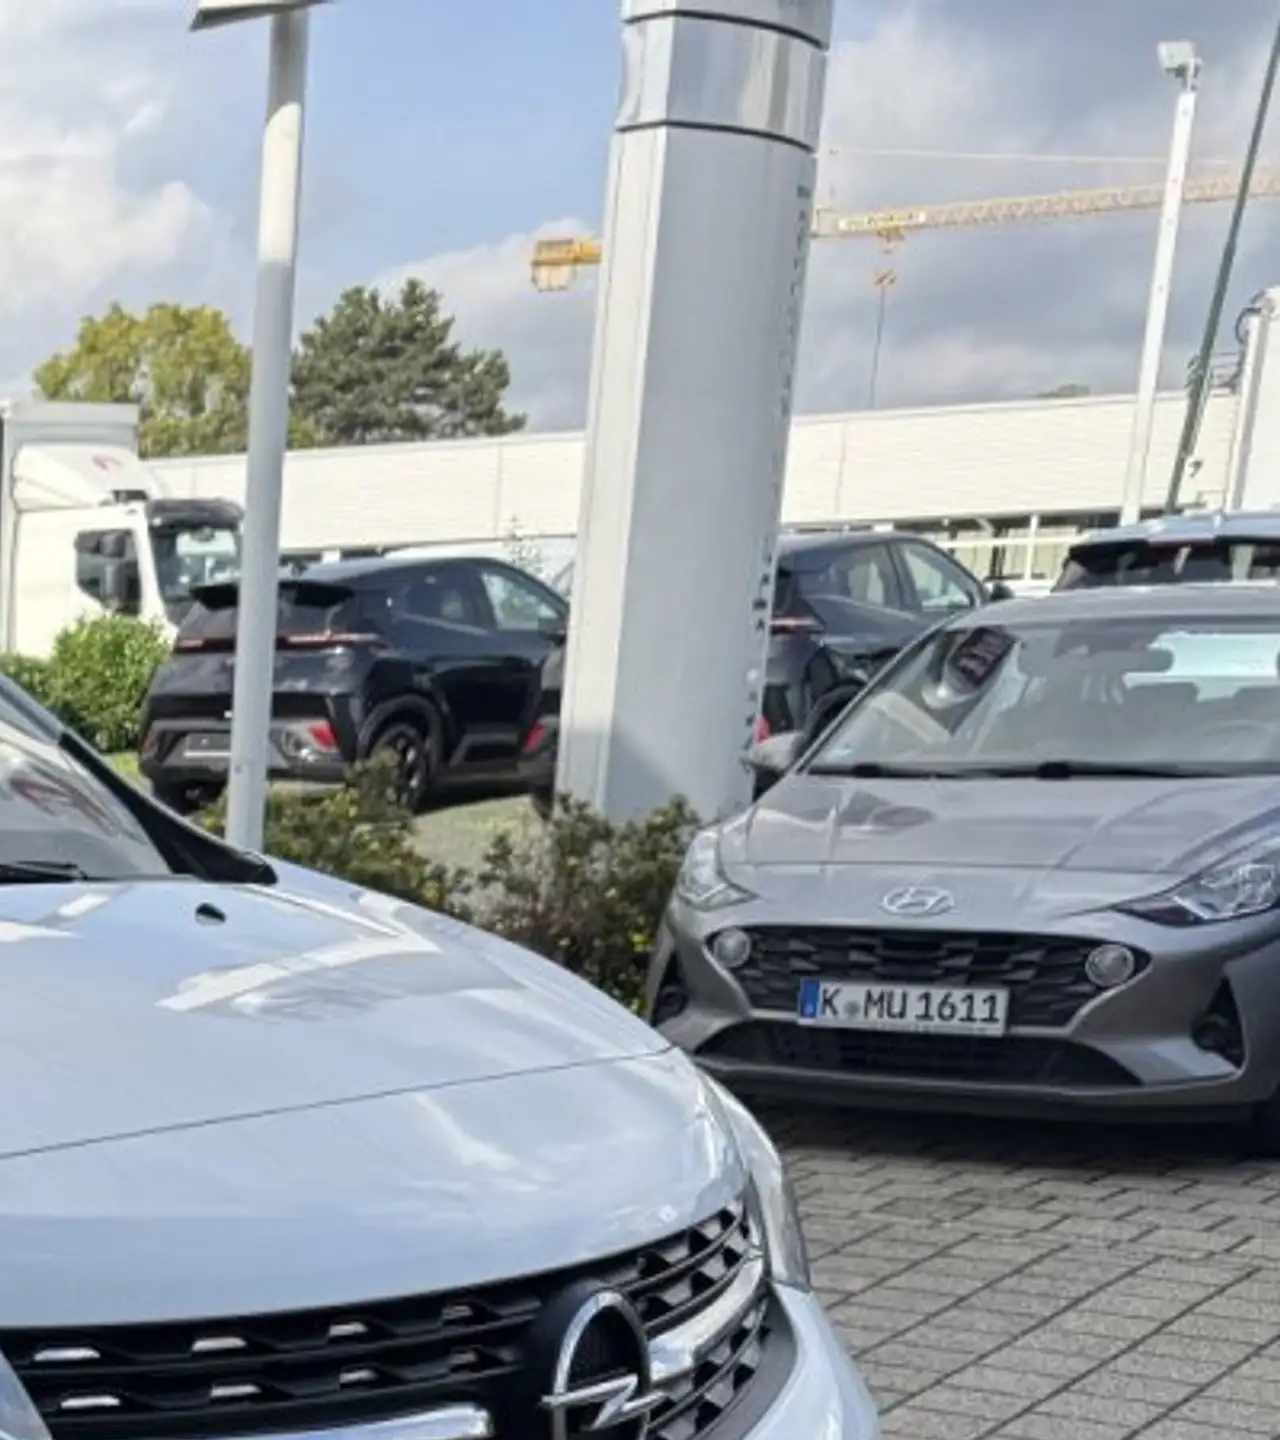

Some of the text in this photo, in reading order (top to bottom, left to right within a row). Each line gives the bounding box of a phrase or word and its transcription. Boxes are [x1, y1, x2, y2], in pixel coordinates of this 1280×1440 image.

[822, 987, 1000, 1023] K MU 1611
